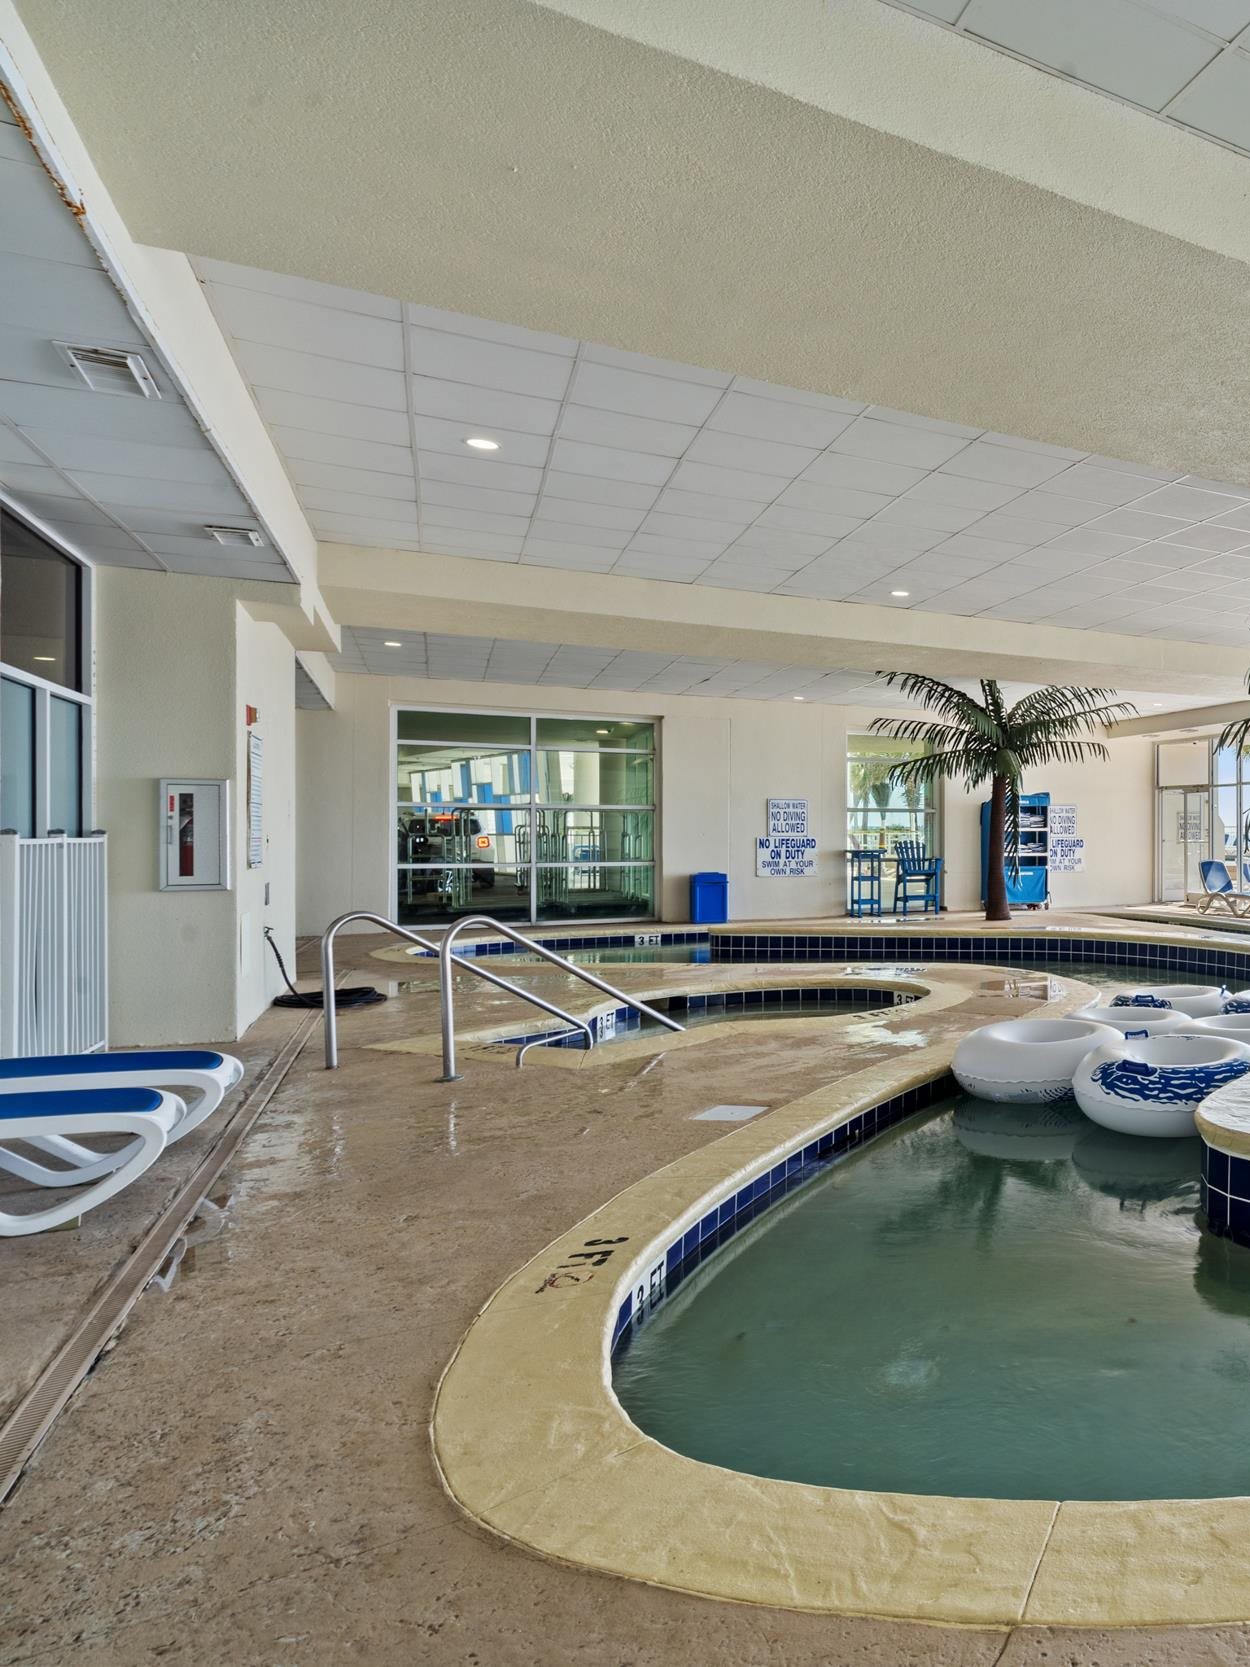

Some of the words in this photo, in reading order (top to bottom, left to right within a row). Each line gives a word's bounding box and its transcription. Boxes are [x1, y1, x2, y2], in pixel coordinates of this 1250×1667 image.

[771, 802, 790, 810] SHALLOW
[792, 802, 806, 810] WATER
[771, 811, 781, 821] NO
[783, 811, 806, 821] DIVING
[1058, 815, 1075, 825] DIVING
[772, 822, 806, 833] ALLOWED
[759, 838, 771, 849] NO
[774, 838, 817, 849] LIFEGUARD
[1052, 839, 1084, 848] LIFEGUARD
[770, 849, 781, 860] ON
[785, 849, 806, 860] DUTY
[1060, 848, 1076, 858] DUTY
[762, 860, 780, 868] SWIM
[795, 860, 814, 868] YOUR
[789, 867, 805, 875] RISK
[638, 936, 644, 945] 3
